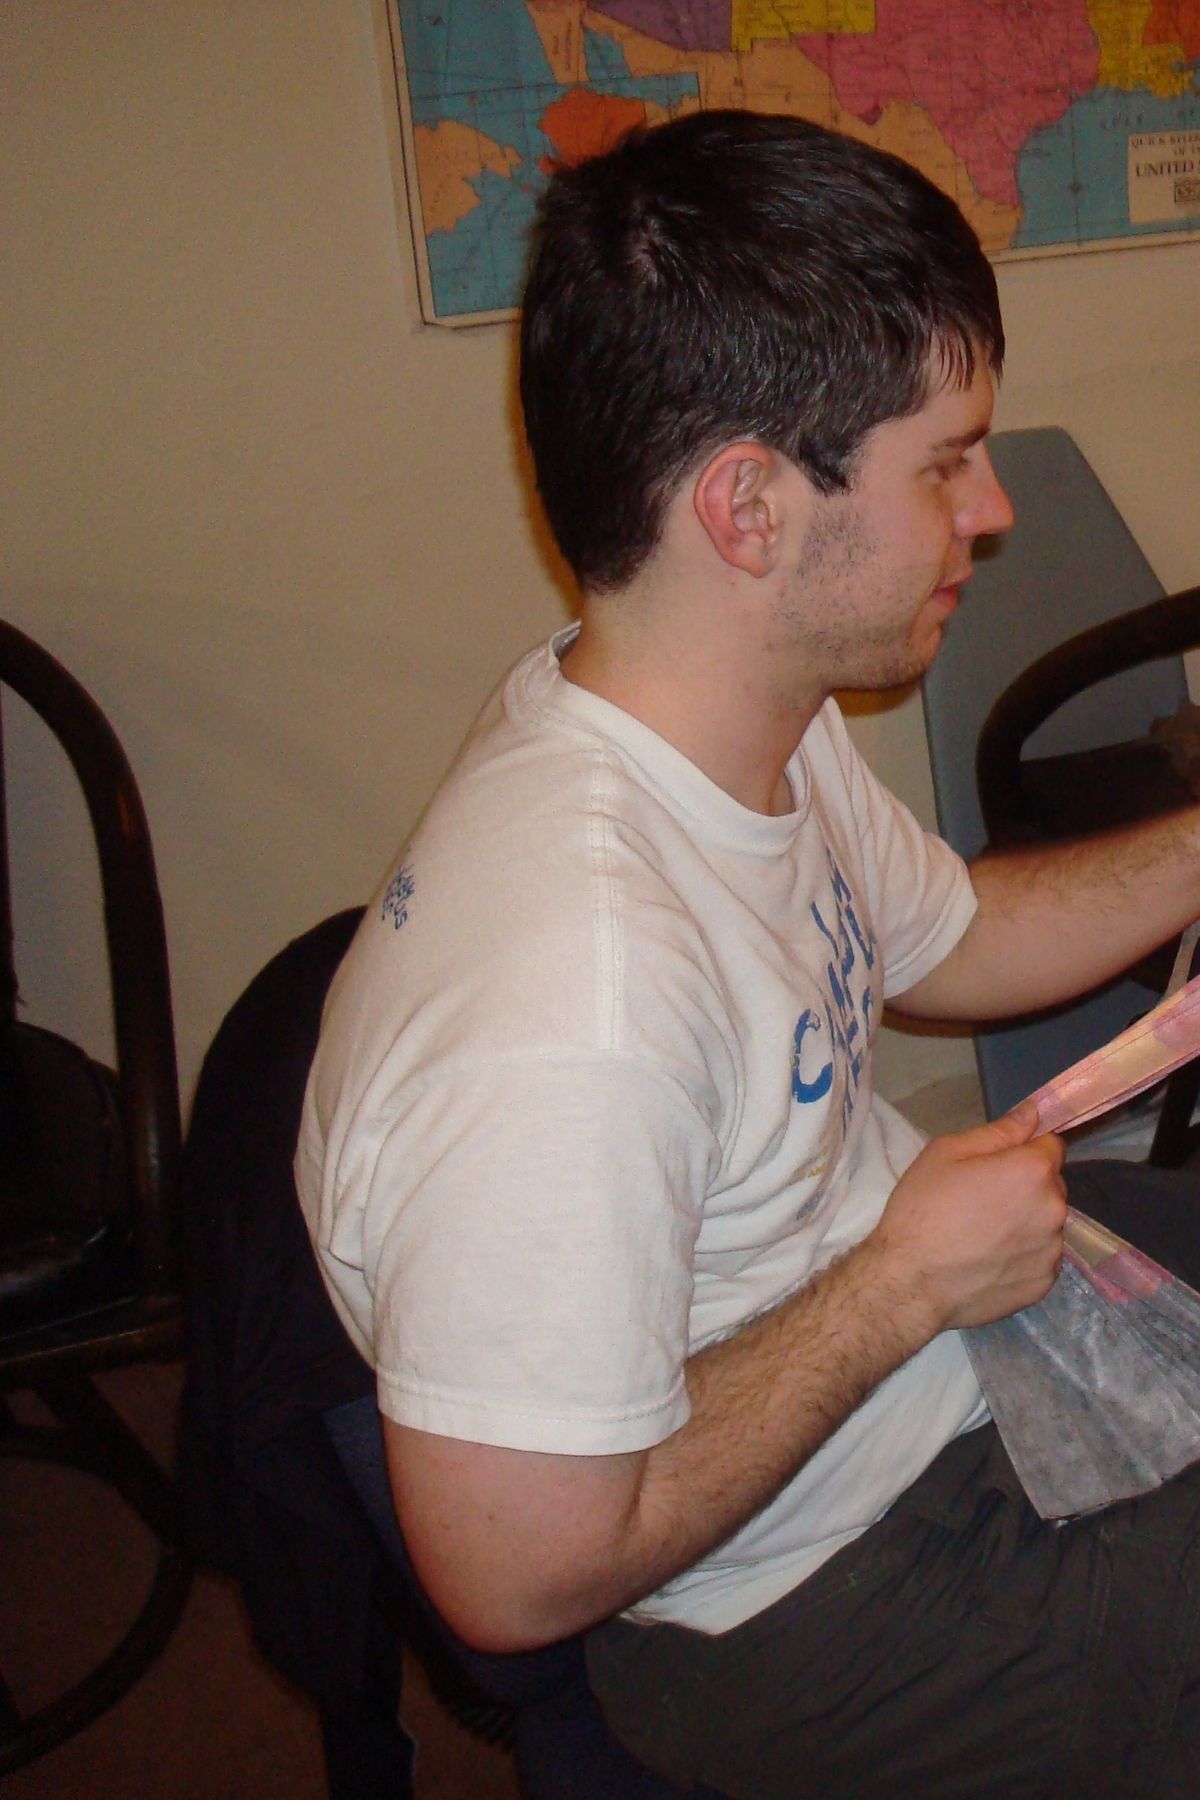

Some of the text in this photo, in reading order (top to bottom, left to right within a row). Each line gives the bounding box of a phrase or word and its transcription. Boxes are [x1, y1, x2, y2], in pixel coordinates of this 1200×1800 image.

[1131, 137, 1166, 148] QUICK
[1174, 148, 1186, 157] OF
[1135, 158, 1194, 178] UNITED
